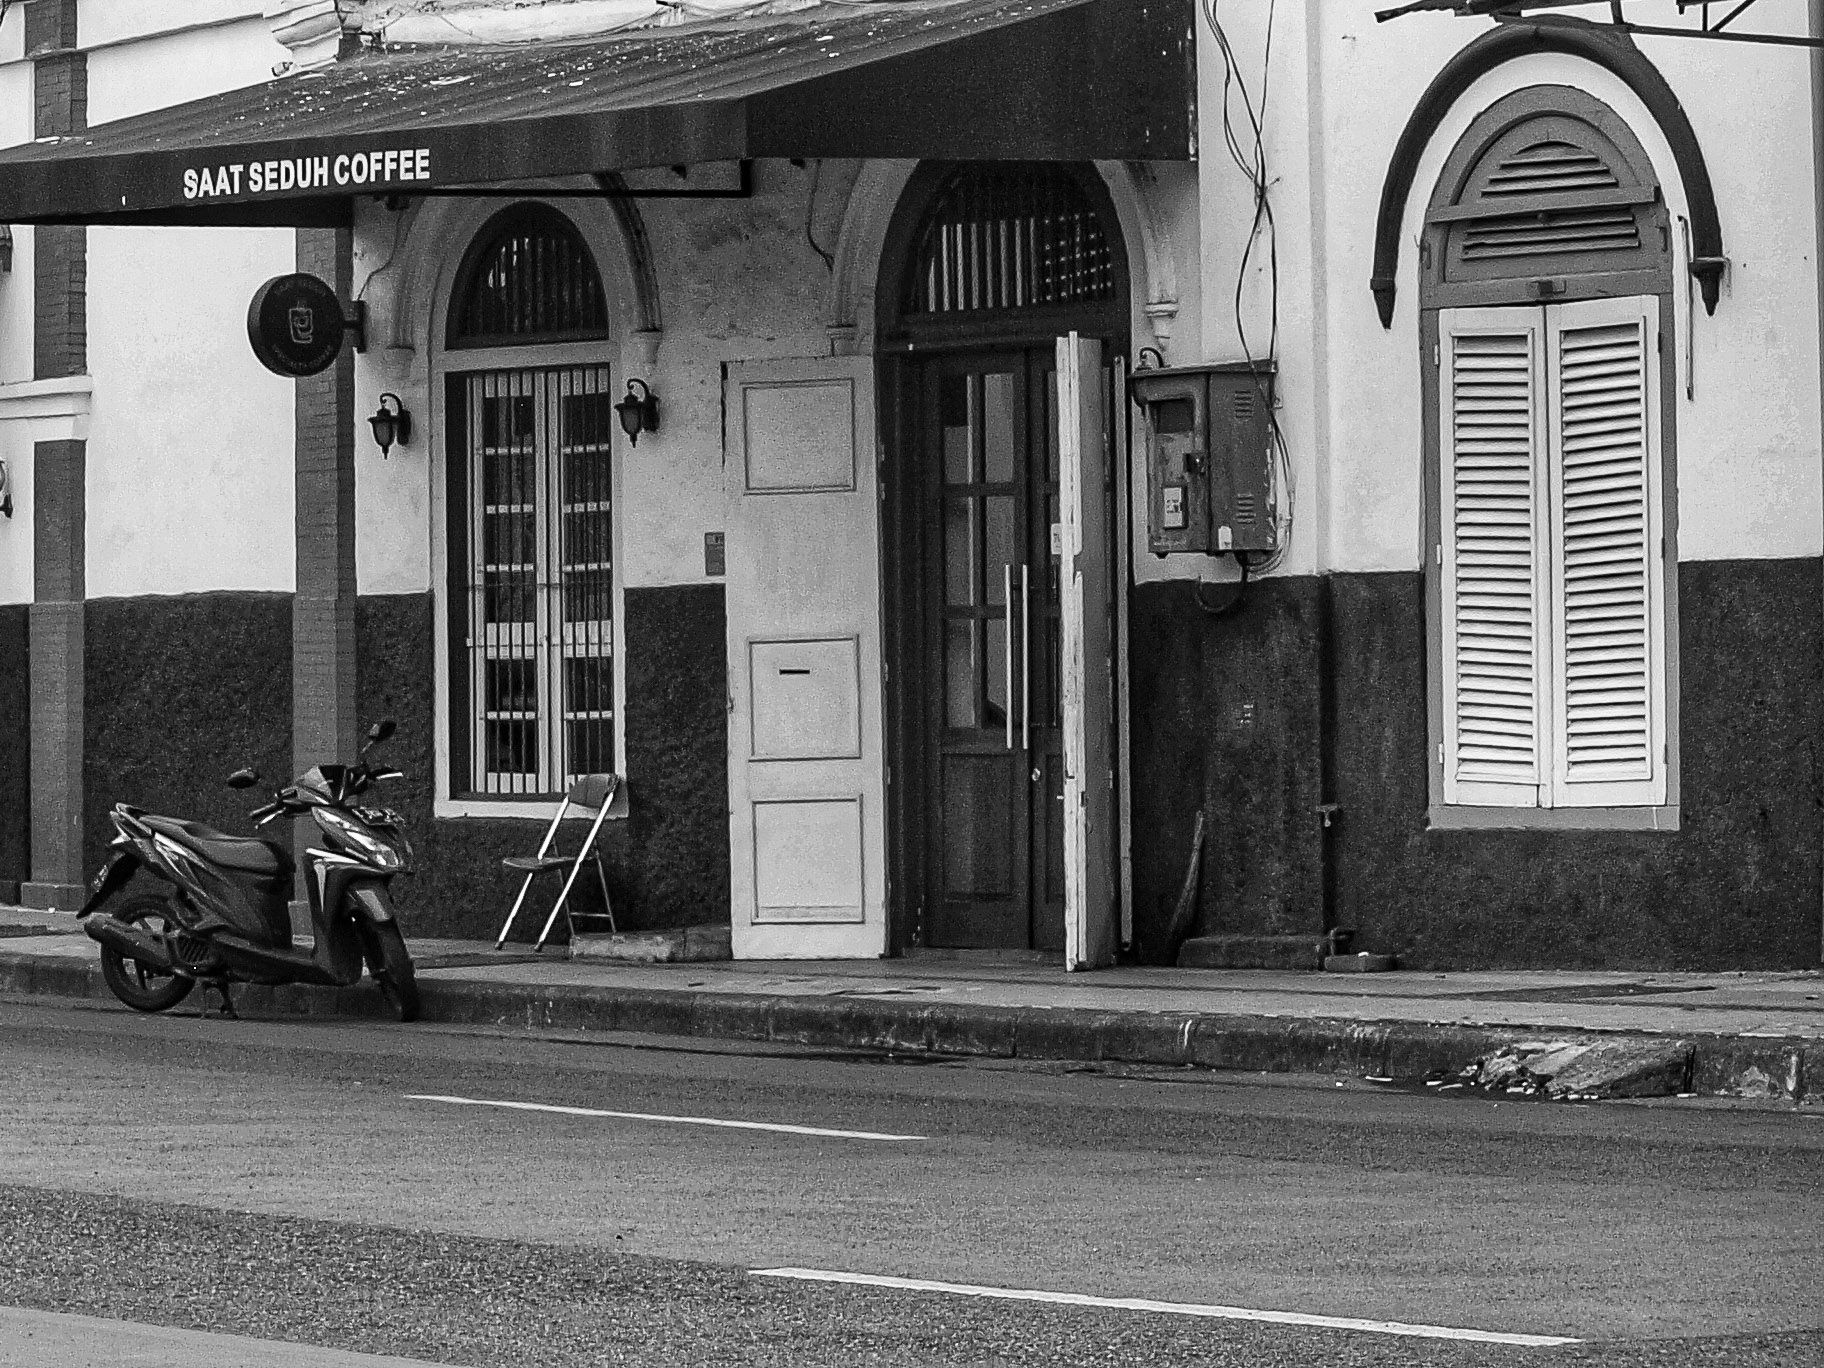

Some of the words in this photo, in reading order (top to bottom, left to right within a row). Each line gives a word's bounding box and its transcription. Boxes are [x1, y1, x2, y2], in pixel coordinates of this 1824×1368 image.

[183, 164, 244, 199] SAAT
[249, 156, 329, 192] SEDUH
[334, 148, 430, 185] COFFEE
